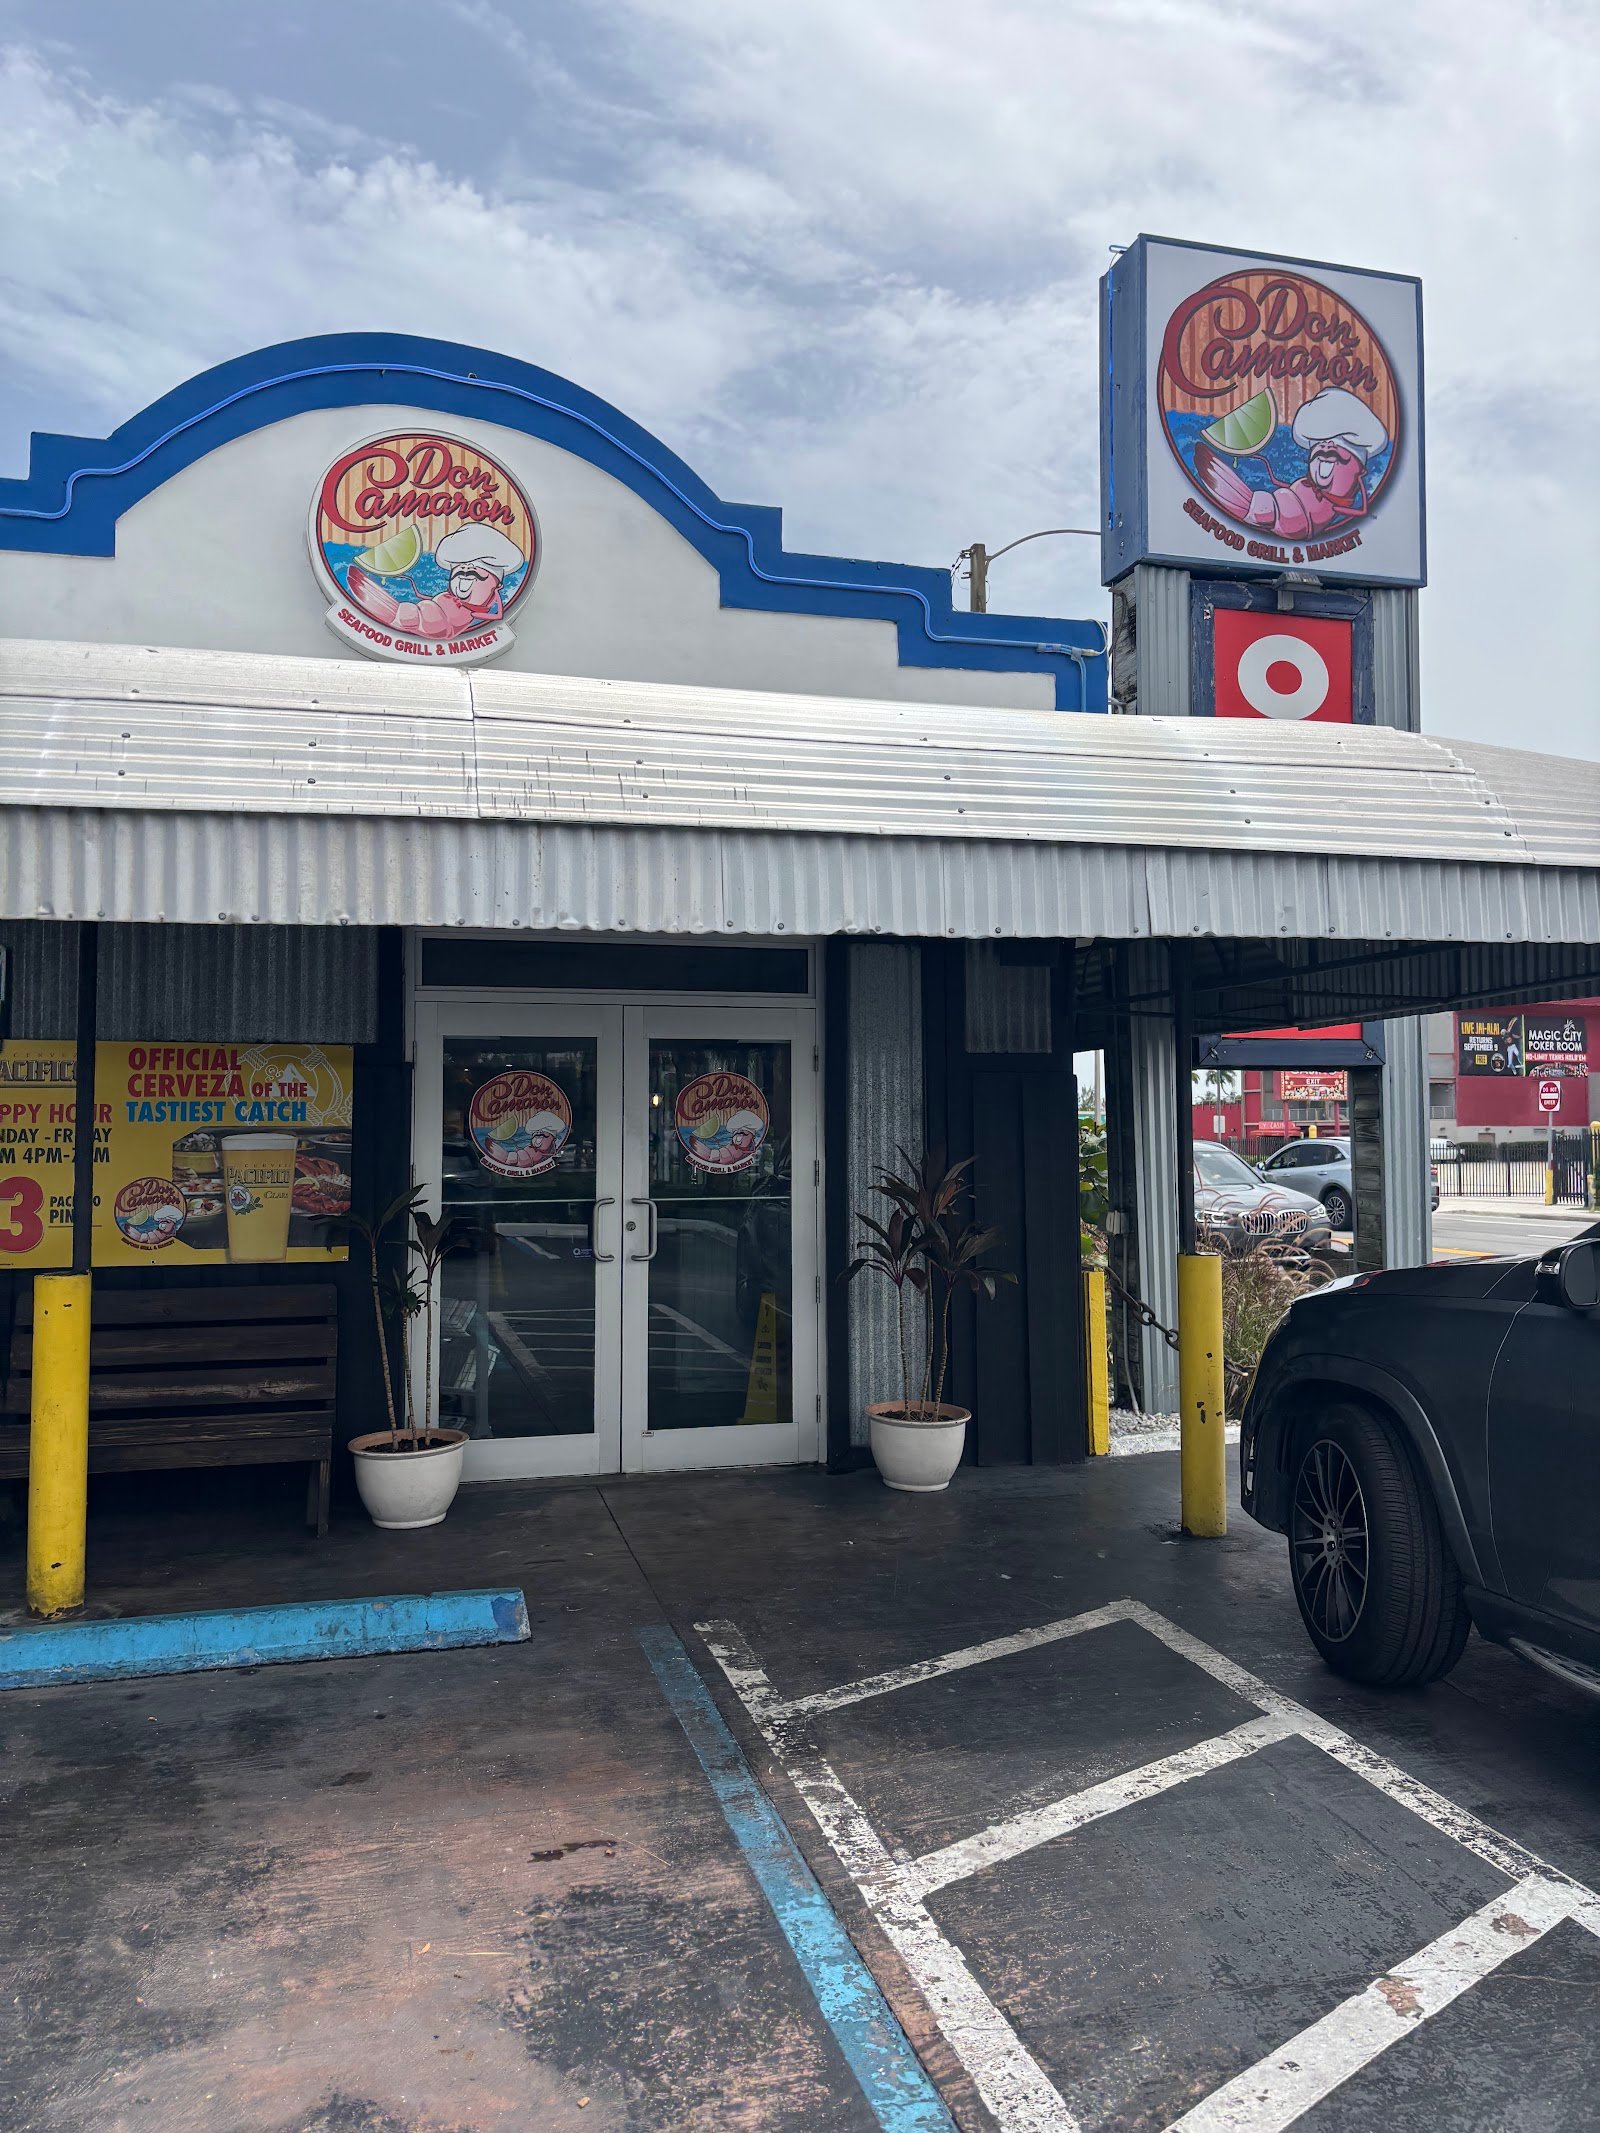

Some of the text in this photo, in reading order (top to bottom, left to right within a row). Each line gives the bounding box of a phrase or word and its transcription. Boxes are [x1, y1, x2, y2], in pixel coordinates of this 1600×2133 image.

[1257, 279, 1361, 347] Don
[1163, 286, 1378, 399] Camarón
[406, 441, 499, 492] Don
[322, 447, 515, 533] Camarón
[1183, 498, 1363, 563] SEAFOOD GRILL & MARKET
[337, 608, 498, 656] SEAFOOD GRILL & MARKET
[1461, 1022, 1475, 1034] LIVE
[1528, 1030, 1582, 1042] MAGIC CITY
[1464, 1043, 1493, 1051] SEPTEMBER
[1469, 1036, 1493, 1044] RETURNS
[1528, 1041, 1583, 1051] POKER ROOM
[0, 1060, 77, 1081] ACIFIC
[128, 1048, 242, 1071] OFFICIAL
[127, 1073, 308, 1097] CERVEZA OF THE
[510, 1074, 553, 1098] Don
[711, 1075, 753, 1098] Don
[0, 1103, 112, 1123] PPY HOR
[126, 1101, 307, 1122] TASTIEST CATCH
[54, 1127, 112, 1143] FRAY
[143, 1178, 175, 1197] Don
